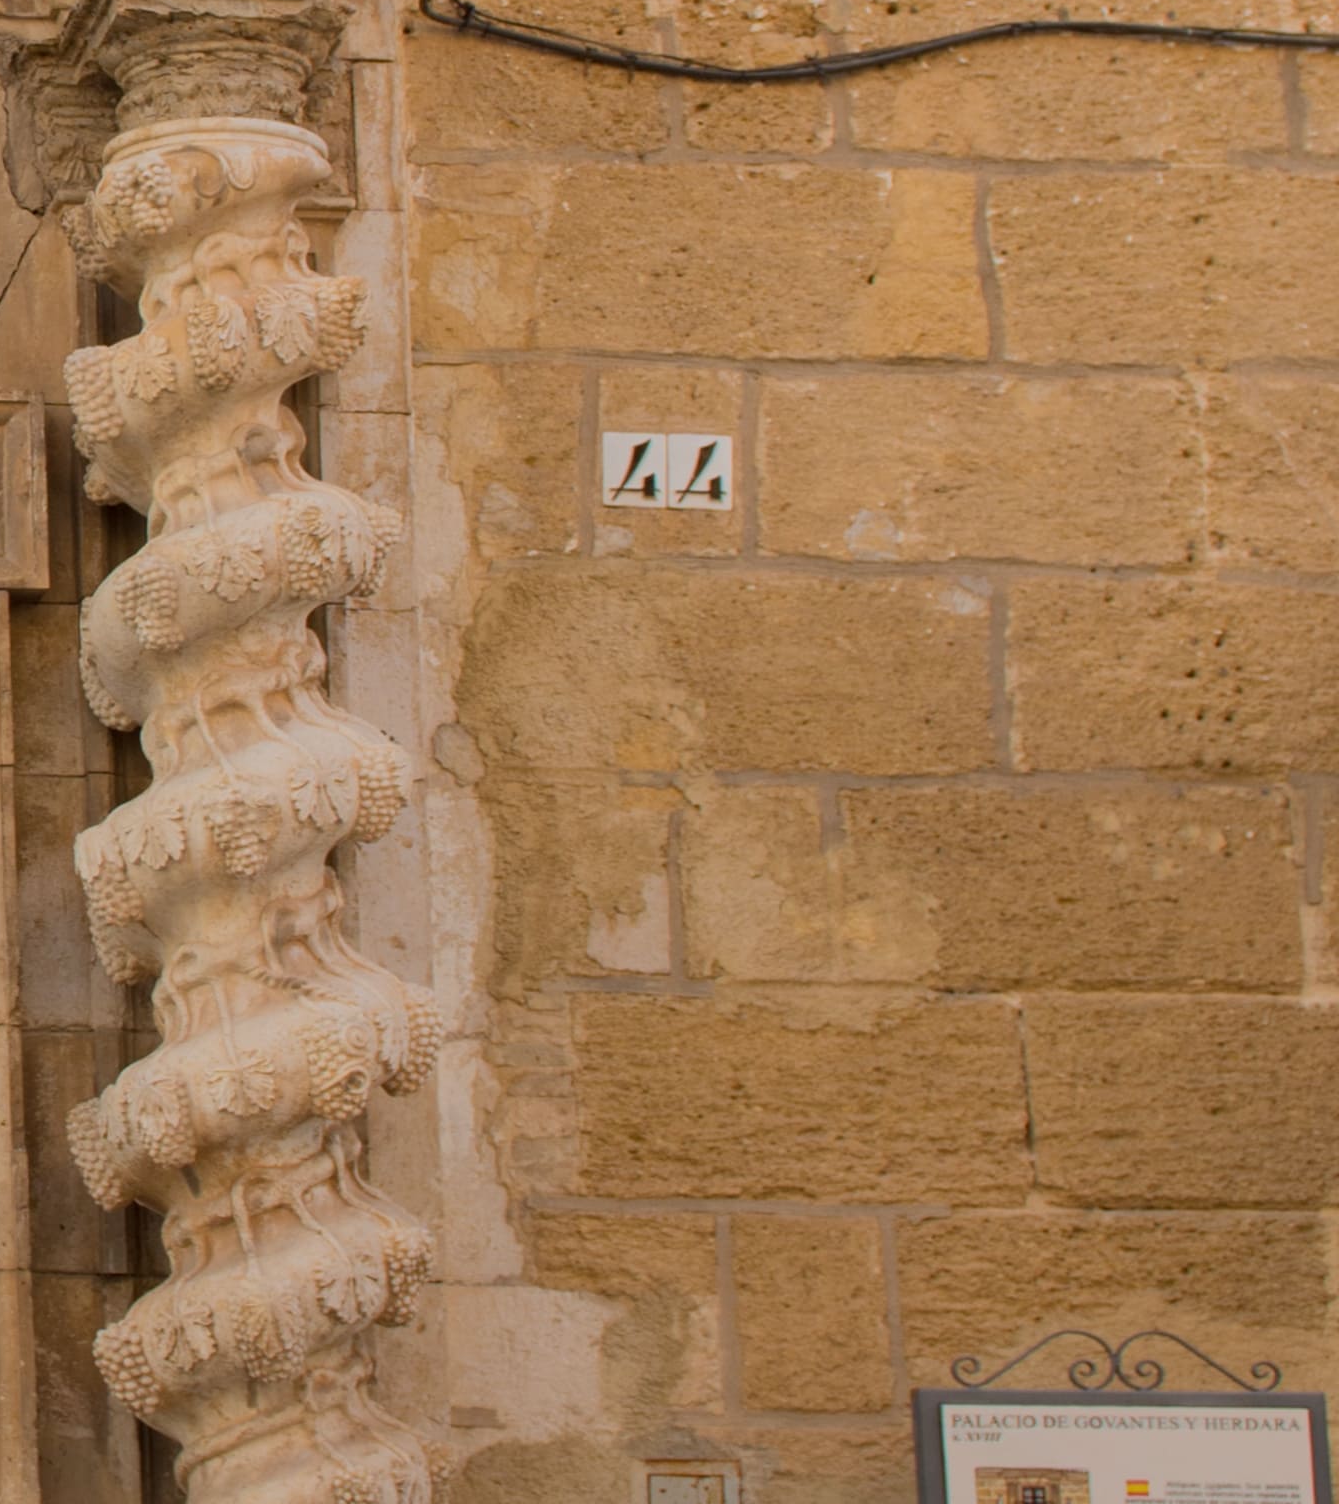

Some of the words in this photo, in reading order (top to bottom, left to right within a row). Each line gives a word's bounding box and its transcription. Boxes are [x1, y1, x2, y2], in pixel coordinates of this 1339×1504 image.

[609, 438, 728, 503] 44
[951, 1413, 1037, 1430] PALACIO
[1042, 1414, 1069, 1429] DE
[1074, 1414, 1180, 1432] GOVANTES
[1184, 1416, 1199, 1432] Y
[1204, 1416, 1301, 1433] HERDARA
